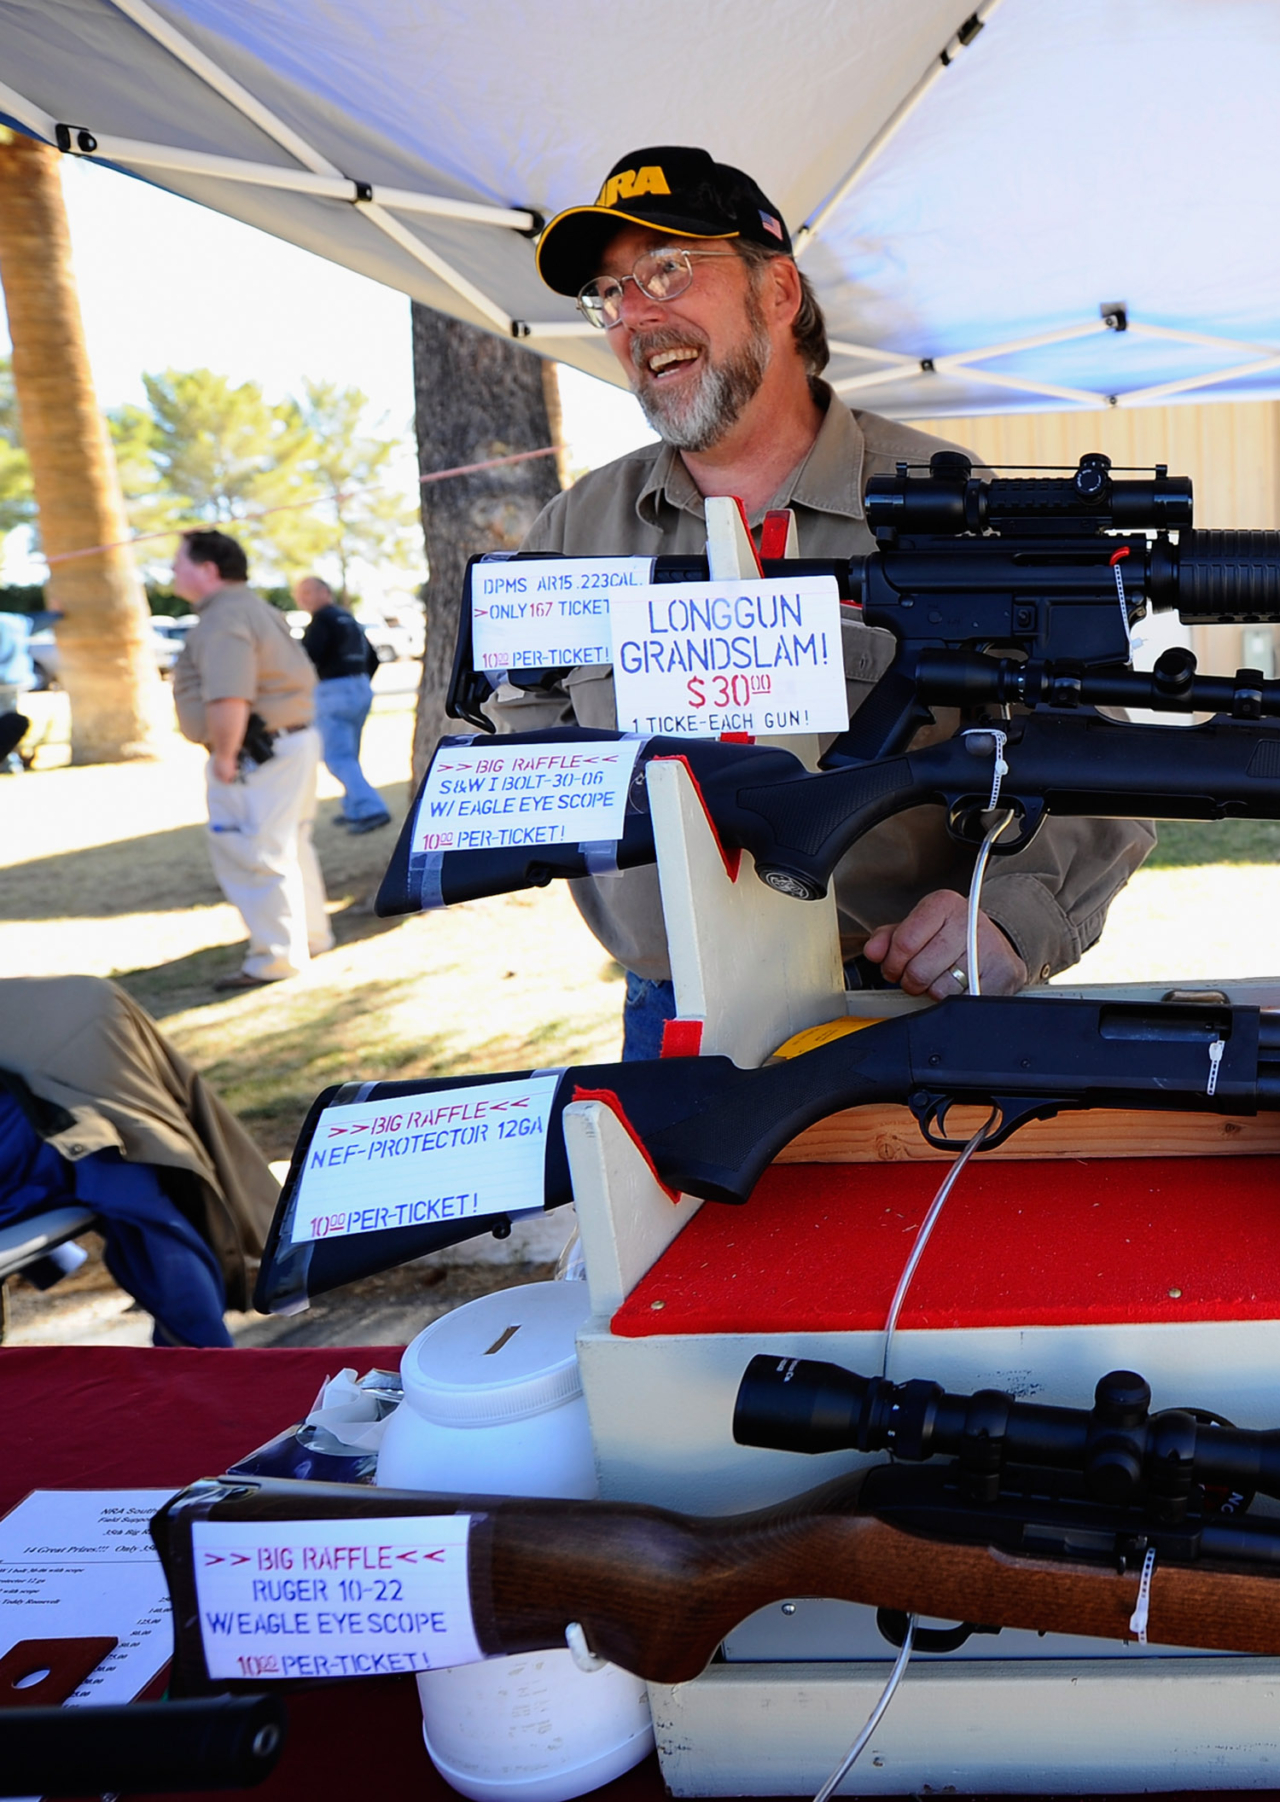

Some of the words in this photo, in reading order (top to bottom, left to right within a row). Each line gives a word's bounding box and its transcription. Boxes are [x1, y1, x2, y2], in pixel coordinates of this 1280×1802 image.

[483, 577, 527, 594] DPMS
[537, 575, 573, 592] AR15
[489, 604, 526, 620] ONLY
[530, 602, 553, 618] 167
[648, 594, 803, 634] LONGGUN
[512, 646, 610, 666] PER-TICKET!
[620, 633, 829, 674] GRANDSLAM!
[632, 719, 639, 734] 1
[765, 710, 810, 729] GUN!
[475, 758, 504, 774] BIG
[512, 755, 584, 772] RAFFLE
[439, 777, 485, 795] S&W
[501, 771, 604, 791] BOLT-30-06
[457, 797, 516, 817] EAGLE
[519, 795, 555, 812] EYE
[558, 791, 616, 810] SCOPE
[457, 825, 566, 848] PER-TICKET!
[370, 1115, 401, 1135] BIG
[406, 1101, 490, 1130] RAFFLE
[310, 1124, 489, 1169] NEF-PROTECTOR
[498, 1116, 543, 1140] 12GA
[347, 1193, 479, 1232] PER-TICKET!
[257, 1547, 294, 1571] BIG
[302, 1546, 393, 1571] RAFFLE
[252, 1579, 329, 1602] RUGER
[338, 1579, 403, 1602] 10-22
[238, 1612, 311, 1635] EAGLE
[318, 1613, 364, 1634] EYE
[368, 1612, 447, 1633] SCOPE
[281, 1652, 432, 1676] PER-TICKET!
